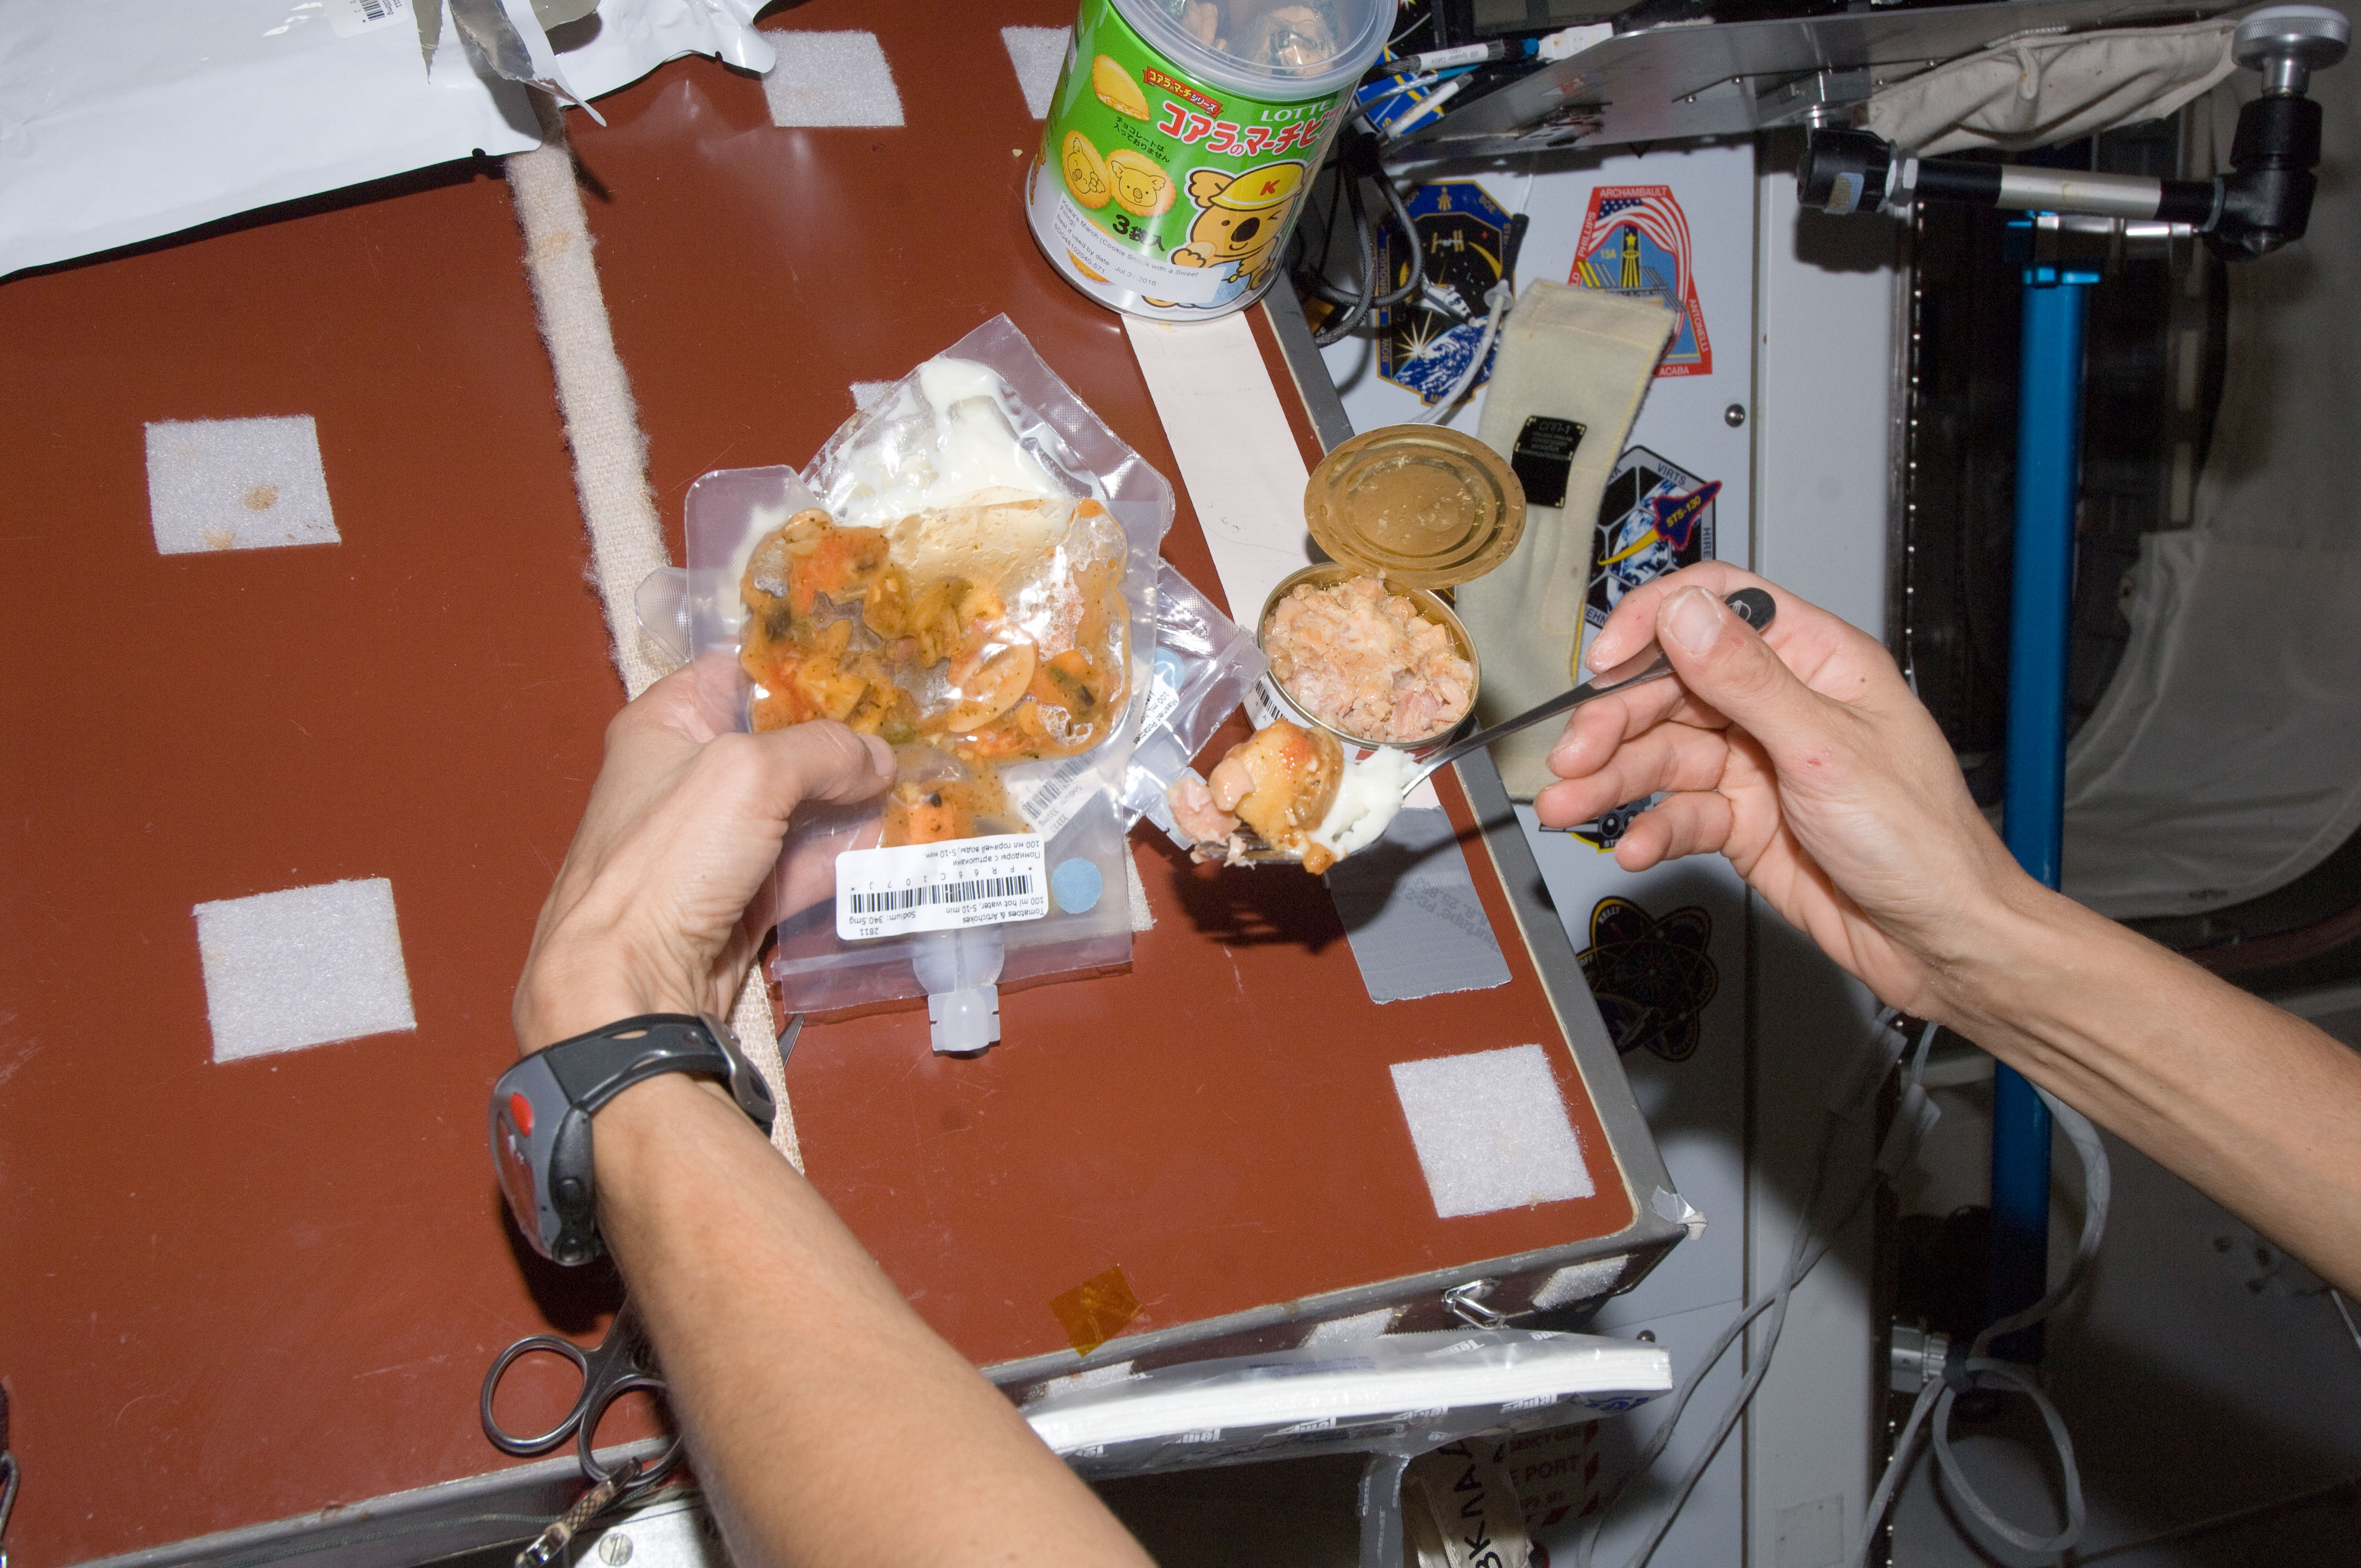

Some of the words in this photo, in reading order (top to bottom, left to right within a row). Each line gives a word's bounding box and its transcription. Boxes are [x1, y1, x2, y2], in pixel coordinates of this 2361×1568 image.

[1261, 100, 1332, 122] LOTTE
[1116, 116, 1166, 153] チョコレートは
[1113, 124, 1170, 163] 入っておりません
[1260, 179, 1280, 196] K
[1600, 187, 1667, 198] ARCHAMBAULT
[1060, 206, 1076, 227] Filling)
[1057, 214, 1068, 230] Best
[1071, 232, 1086, 248] used
[1086, 246, 1095, 257] by
[1062, 199, 1080, 222] Koala's
[1080, 220, 1099, 239] March
[1100, 236, 1125, 257] (Cookie
[1127, 254, 1150, 267] Snack
[1151, 263, 1166, 273] with
[1175, 269, 1199, 277] Sweet
[1112, 214, 1165, 252] 3袋入
[1577, 211, 1596, 257] PHILLIPS
[1689, 298, 1710, 352] ANTONELLI
[1659, 366, 1690, 376] ACABA
[1657, 462, 1687, 486] VIRTS
[1666, 496, 1701, 527] STS-130
[1702, 527, 1711, 559] HIRE
[1156, 697, 1178, 721] Mashed
[957, 845, 979, 855] воды,
[981, 840, 1011, 853] горячей
[1026, 840, 1040, 850] 100
[940, 848, 956, 858] 5-10
[1001, 851, 1041, 861] Помидоры
[979, 901, 1002, 911] water,
[1004, 900, 1017, 909] hot
[1031, 897, 1044, 905] 100
[945, 907, 960, 915] min
[962, 904, 977, 913] 5-10
[1008, 908, 1045, 918] Tomatoes
[849, 915, 884, 925] 340.5mg
[886, 911, 916, 922] Sodium:
[962, 913, 998, 924] Artichokes
[1597, 906, 1621, 924] KELLY
[860, 928, 879, 936] 2811
